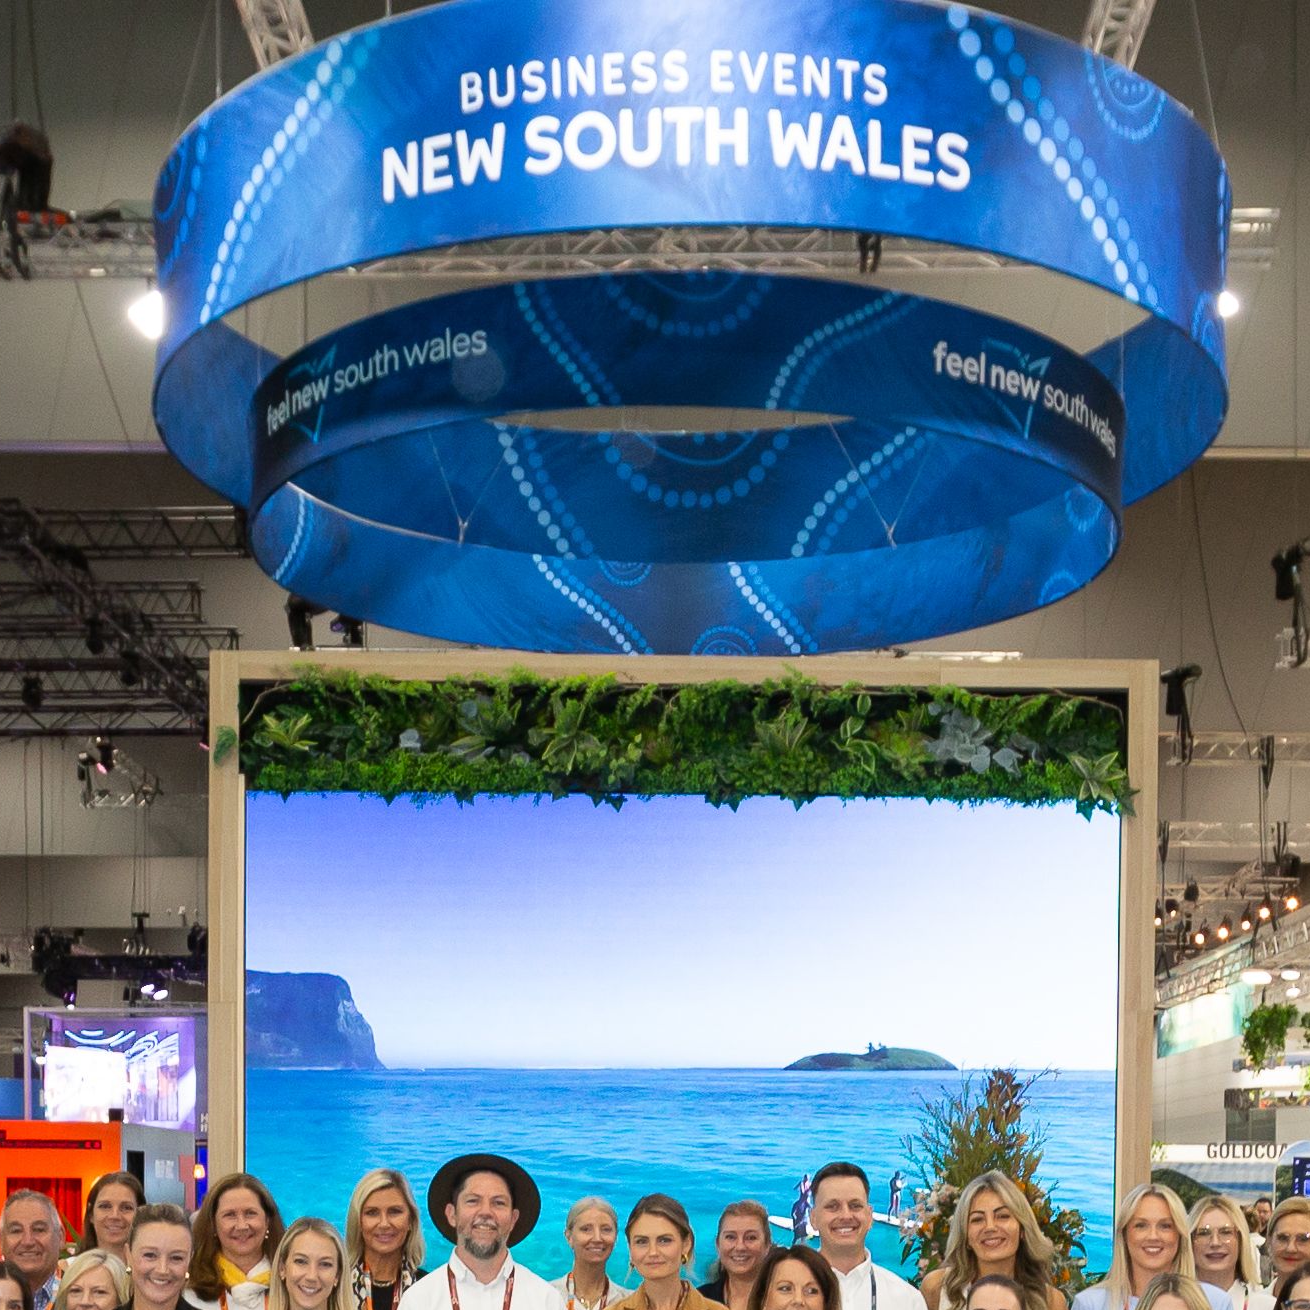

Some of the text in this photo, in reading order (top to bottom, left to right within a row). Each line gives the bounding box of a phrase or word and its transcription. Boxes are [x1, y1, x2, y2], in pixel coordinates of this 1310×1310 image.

[461, 50, 887, 113] BUSINESS EVENTS
[382, 106, 971, 202] NEW SOUTH WALES
[266, 327, 488, 437] feel new south wales
[933, 340, 1116, 459] feel new south wales
